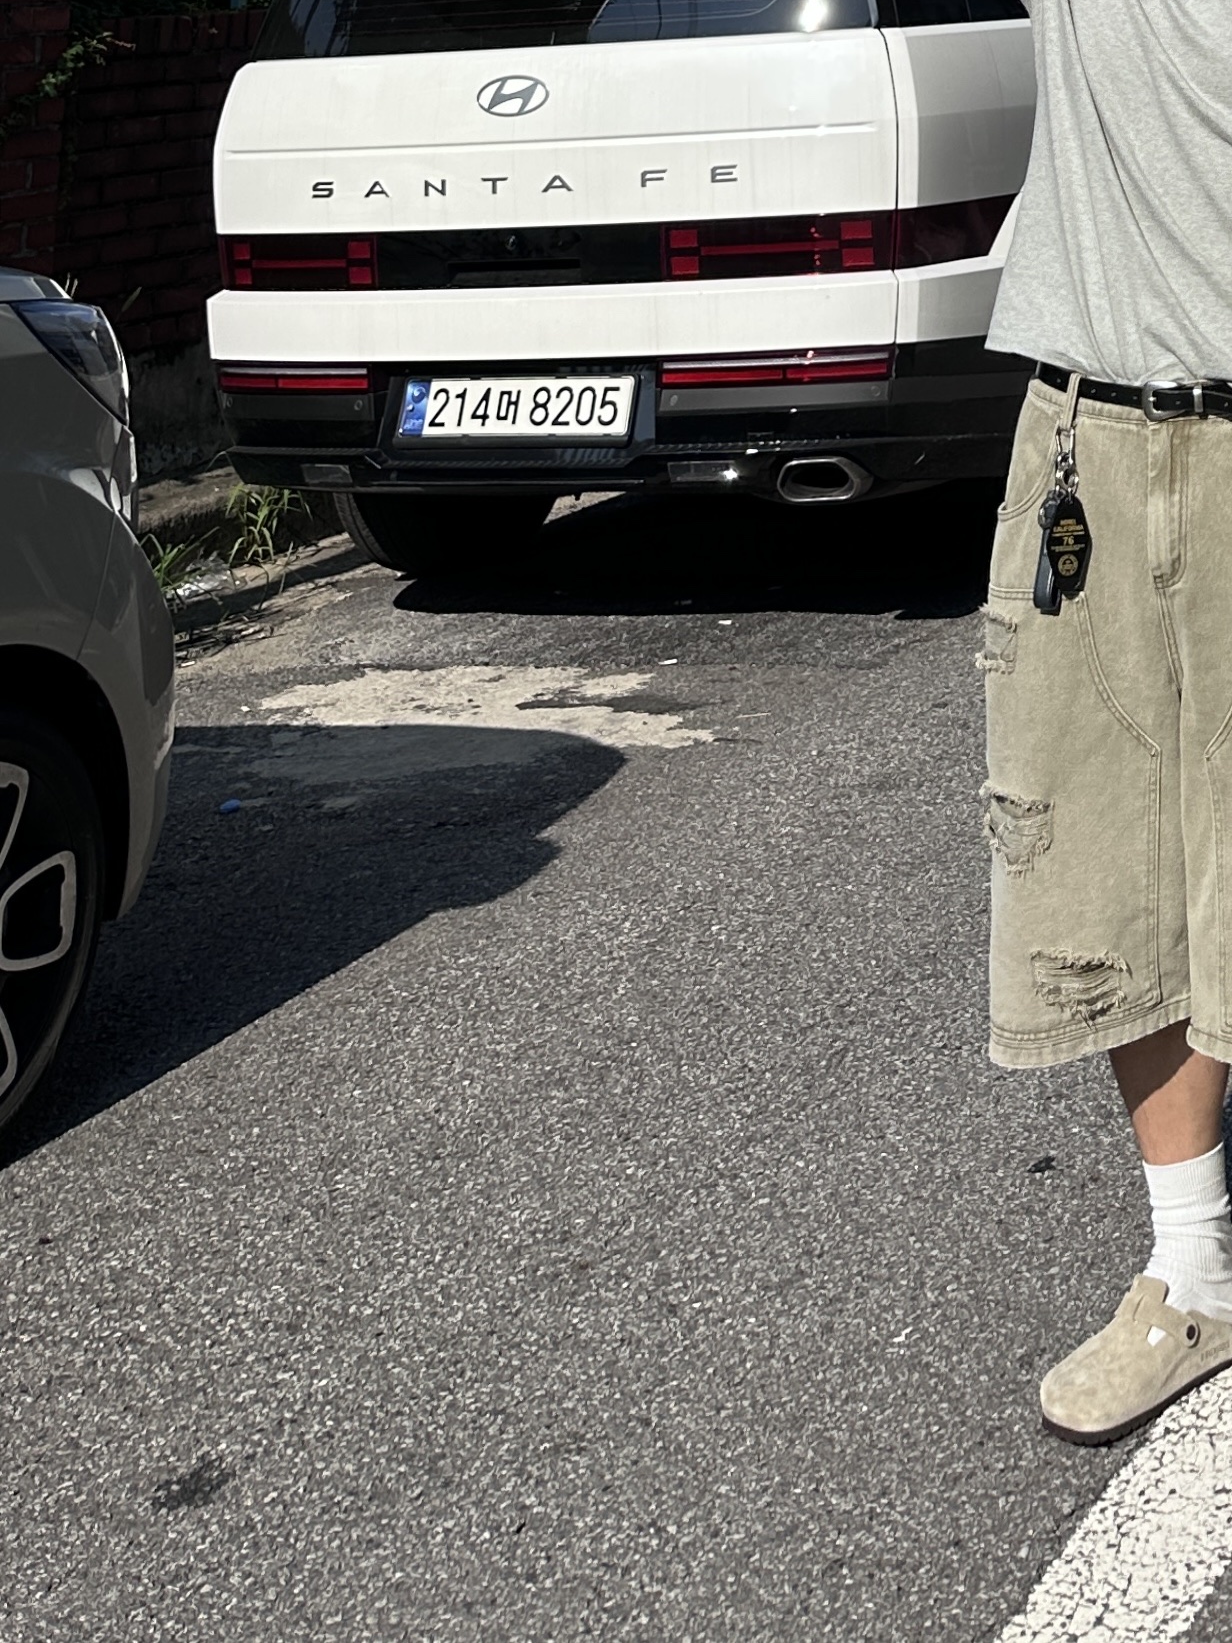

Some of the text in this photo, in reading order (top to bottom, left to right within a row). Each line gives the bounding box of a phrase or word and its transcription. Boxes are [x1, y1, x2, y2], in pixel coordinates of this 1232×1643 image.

[311, 164, 739, 199] SANTA FE
[428, 386, 621, 427] 214머 8205
[1063, 536, 1075, 545] 76
